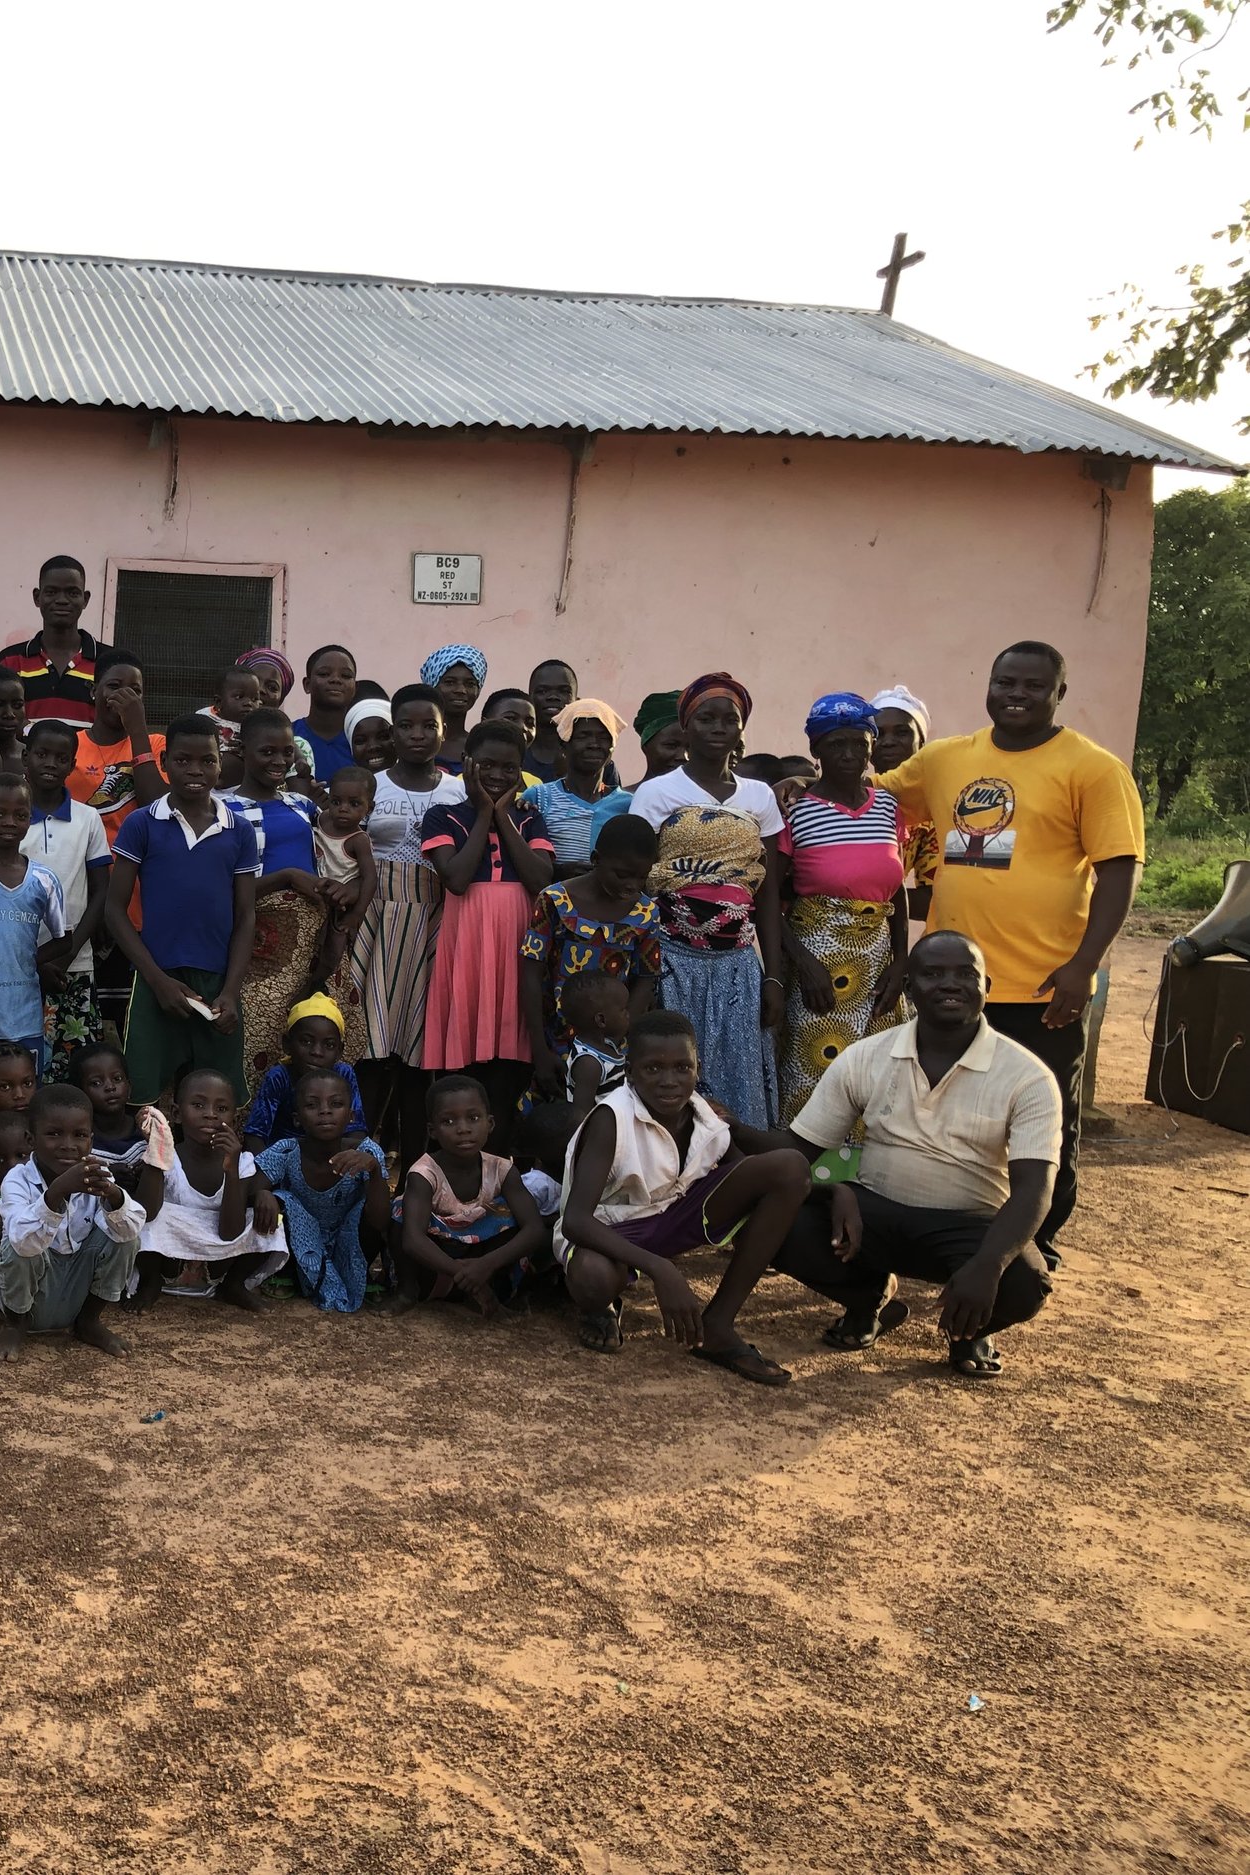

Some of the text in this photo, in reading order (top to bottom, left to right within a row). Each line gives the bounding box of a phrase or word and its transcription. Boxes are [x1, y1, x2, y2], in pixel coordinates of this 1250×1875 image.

[436, 557, 460, 568] BC9
[440, 571, 456, 579] RED
[442, 581, 453, 589] ST
[967, 787, 1007, 806] NIKE
